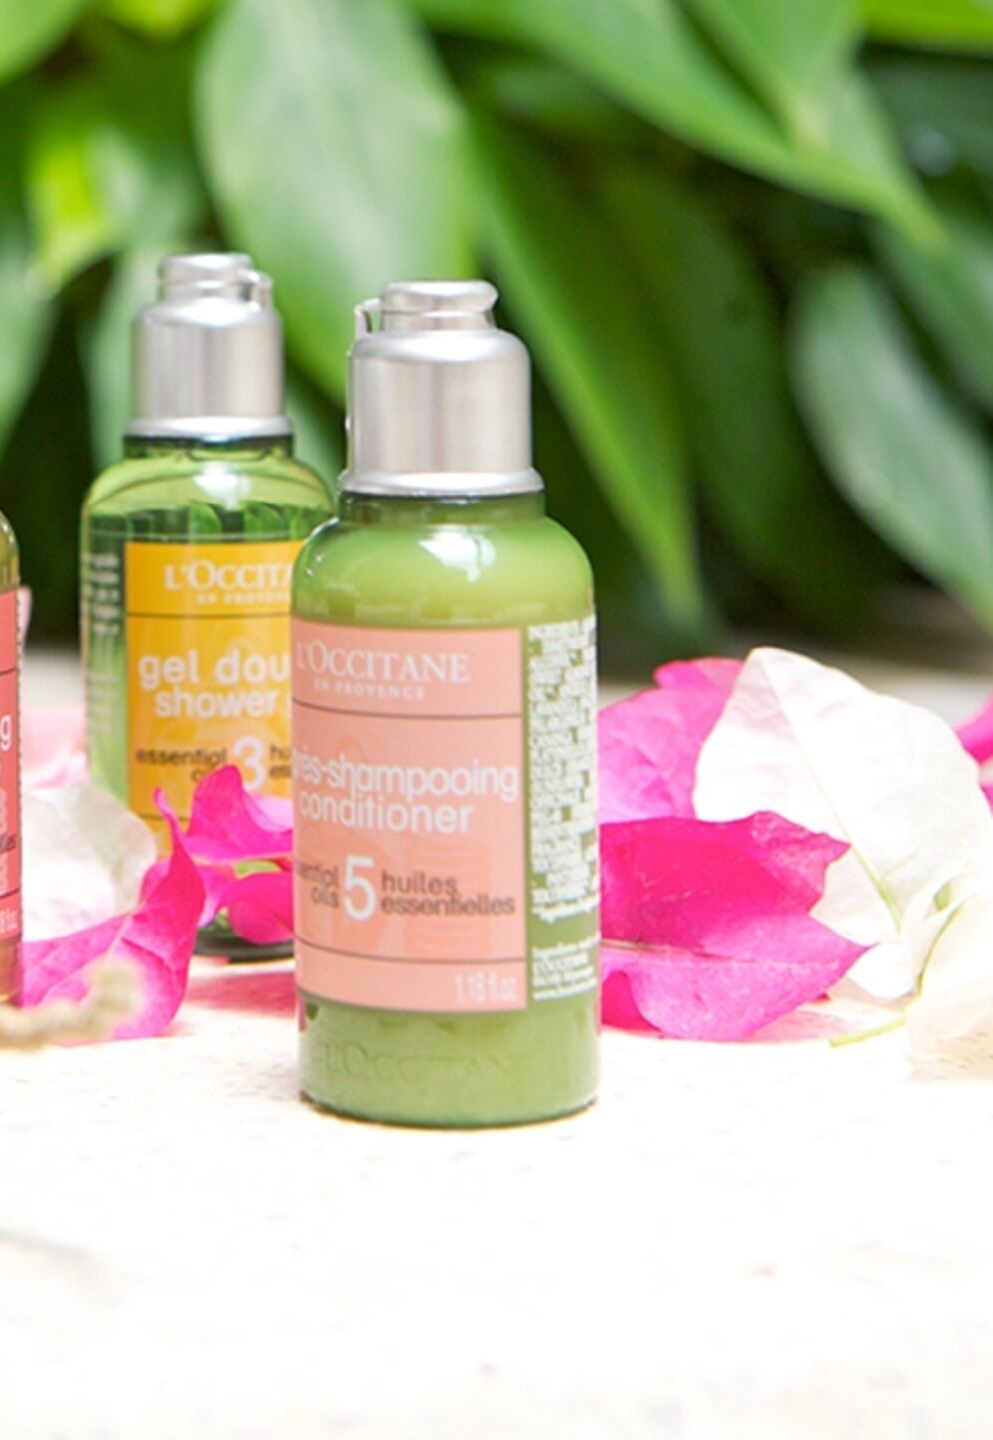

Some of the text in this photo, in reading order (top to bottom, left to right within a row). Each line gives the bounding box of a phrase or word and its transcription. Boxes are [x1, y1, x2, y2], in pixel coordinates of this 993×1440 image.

[163, 558, 291, 591] L'OCCIT
[137, 648, 291, 691] gel dou
[295, 639, 472, 684] L'OCCITANE
[154, 685, 281, 719] shower
[232, 735, 267, 791] 3
[298, 789, 475, 835] conditioner
[342, 854, 377, 922] 5
[381, 870, 459, 895] huiles
[380, 893, 516, 917] essentielles
